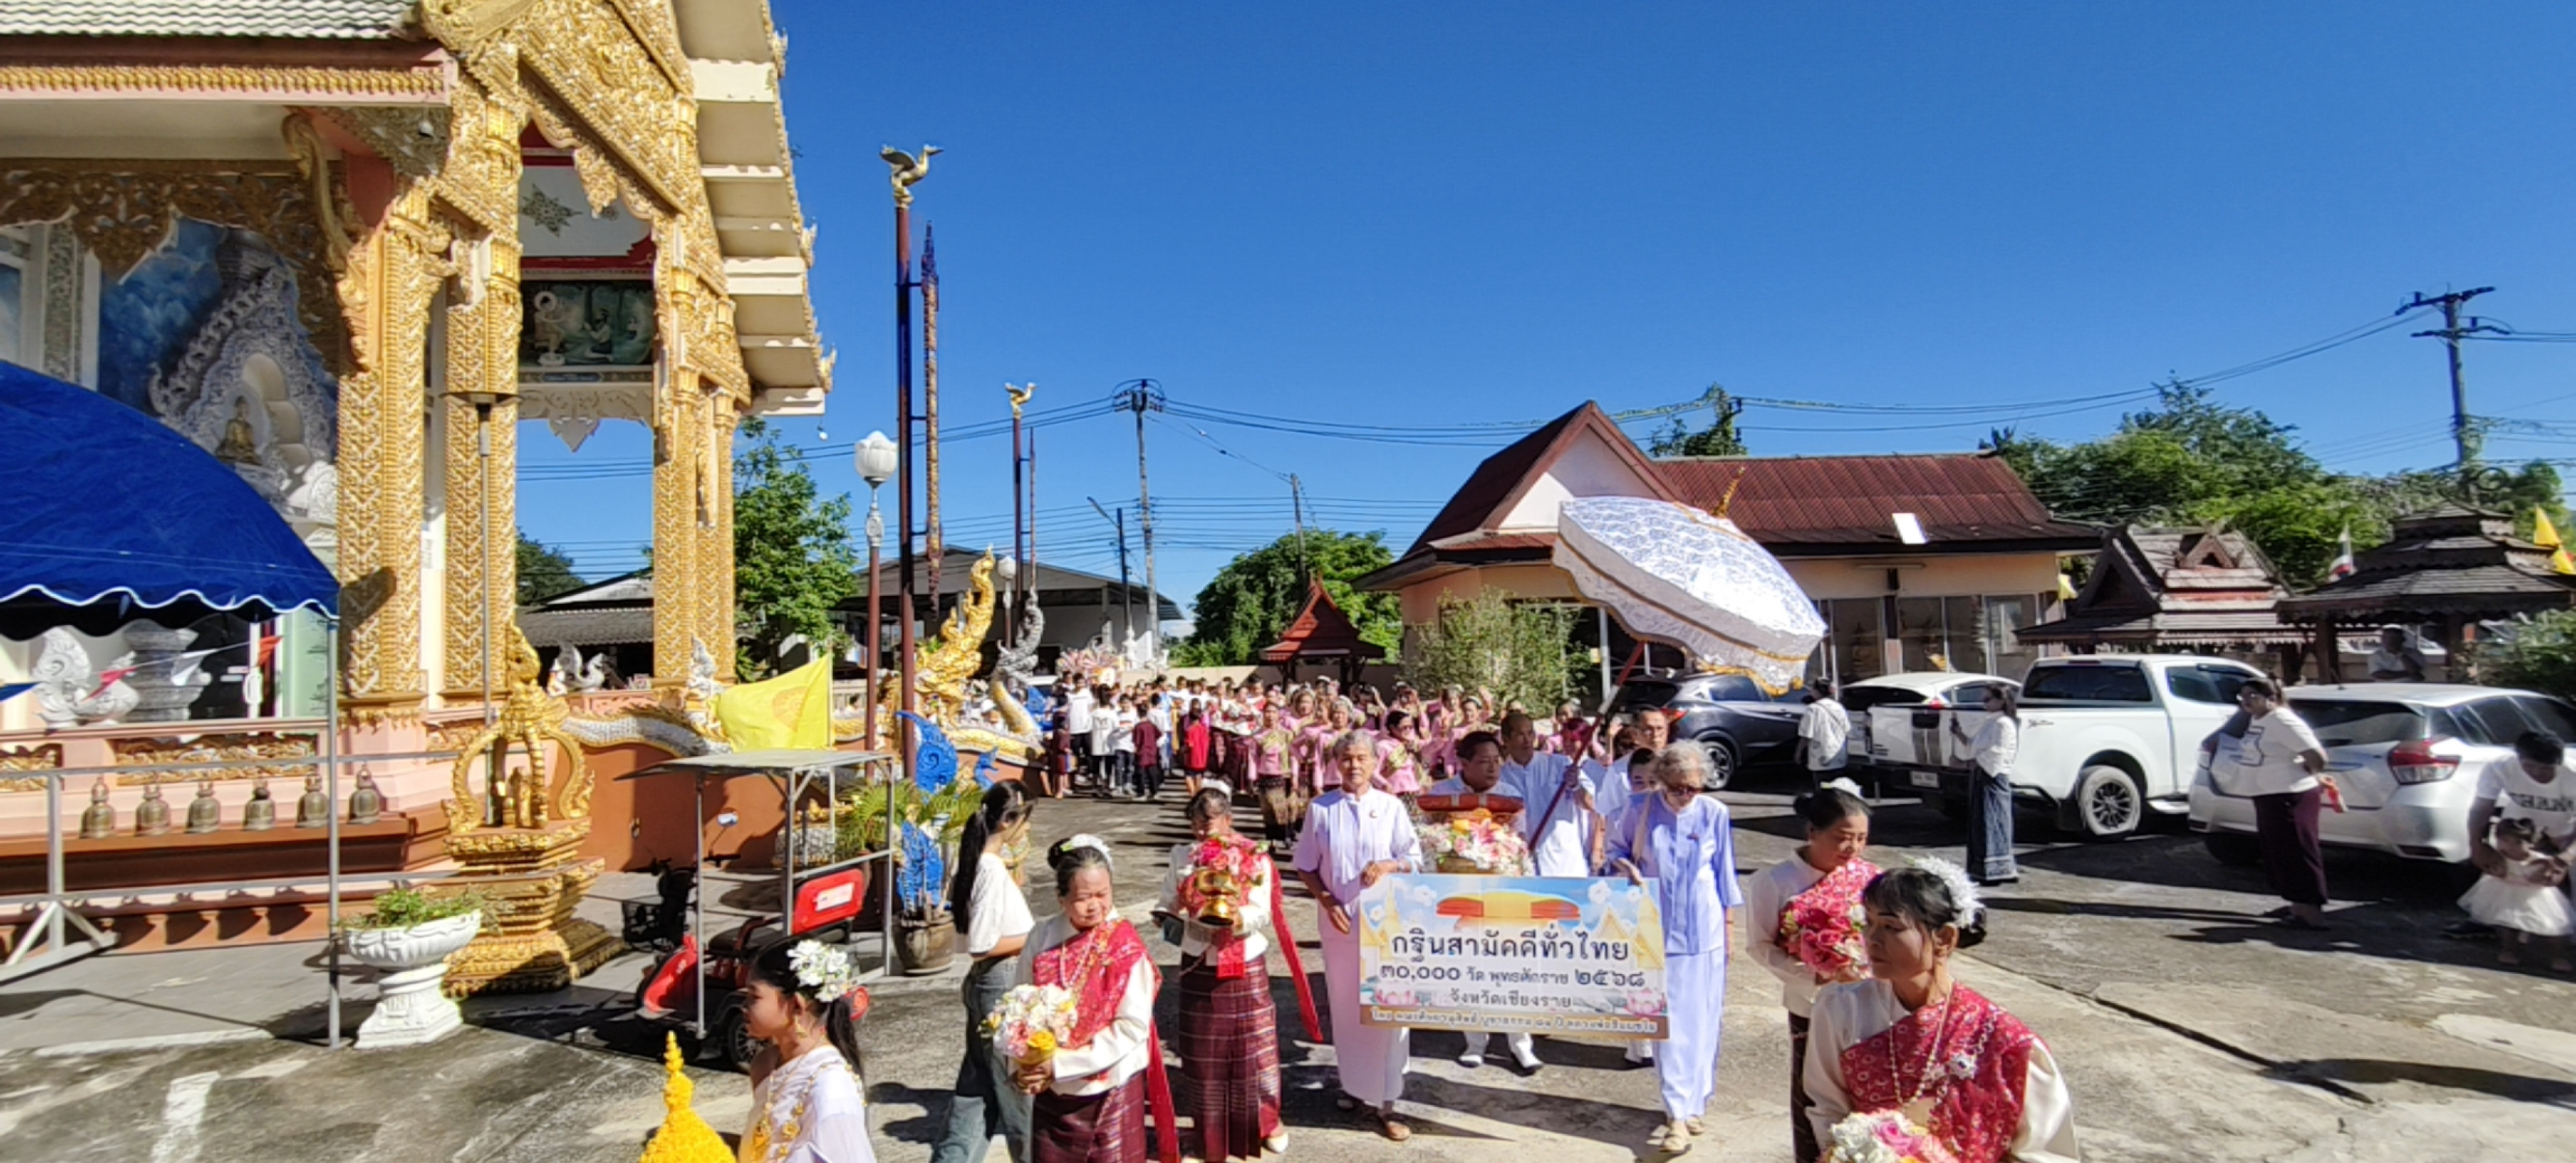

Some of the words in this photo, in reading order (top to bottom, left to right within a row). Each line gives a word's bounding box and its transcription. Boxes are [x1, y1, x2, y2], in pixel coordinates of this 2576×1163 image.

[1381, 965, 1460, 981] ๓๐,๐๐๐
[1574, 969, 1645, 986] ๒๕๖๘
[1449, 988, 1571, 1007] จังหวัดเชียงราย
